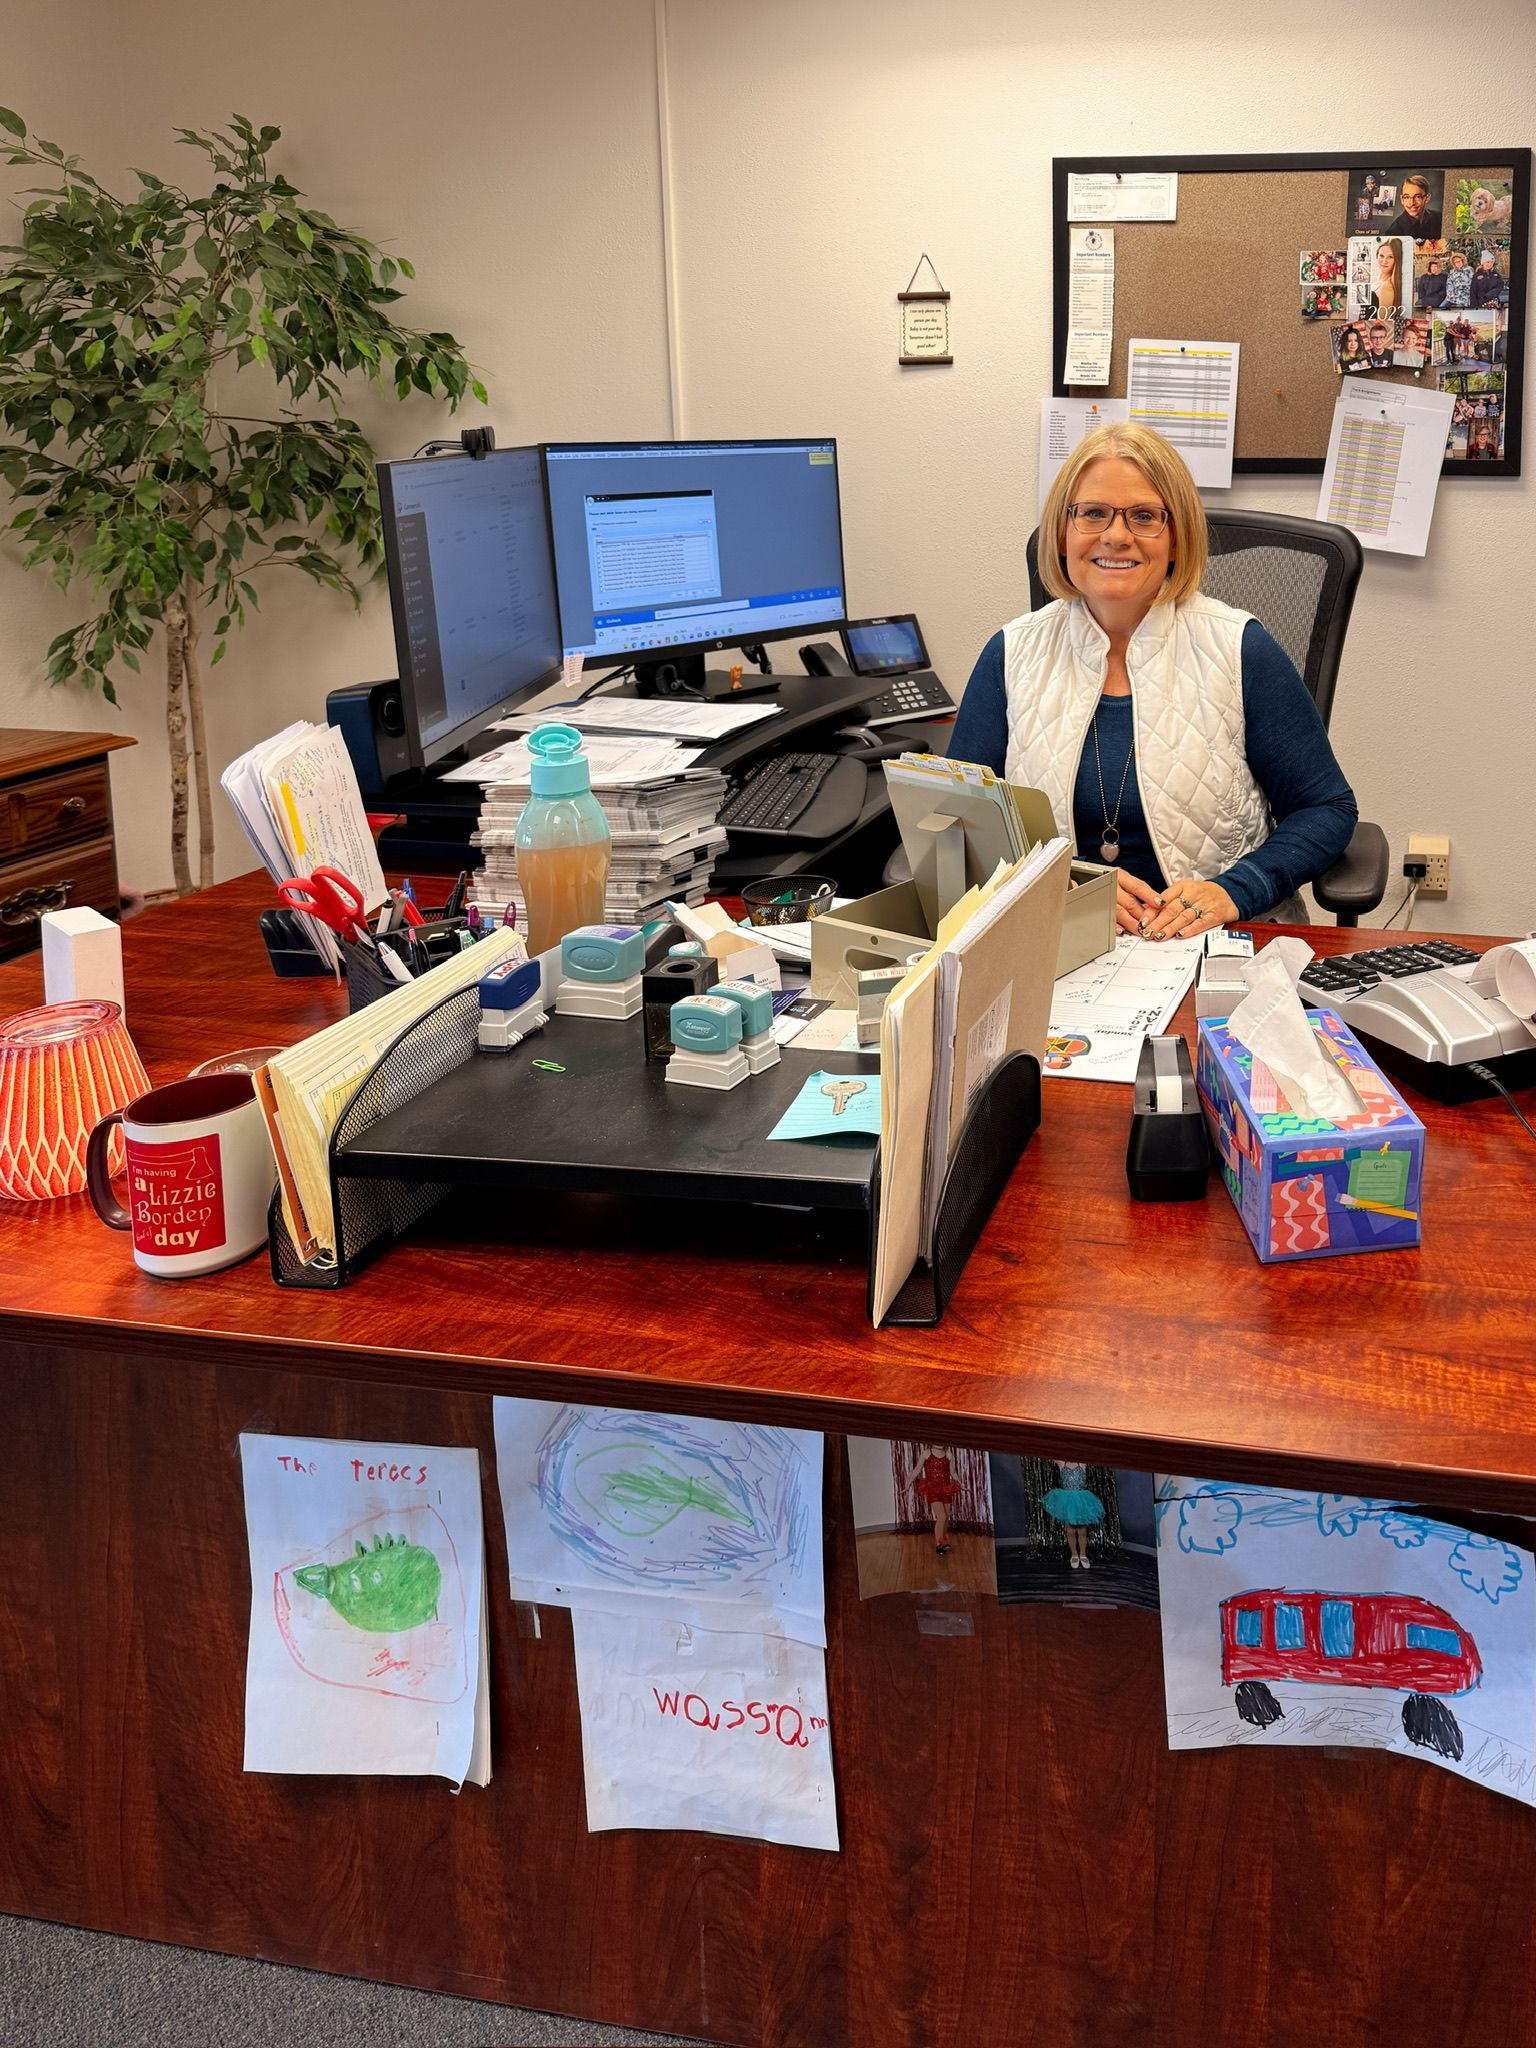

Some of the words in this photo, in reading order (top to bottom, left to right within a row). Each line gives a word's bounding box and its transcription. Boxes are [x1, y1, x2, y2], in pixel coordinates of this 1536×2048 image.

[1093, 1029, 1134, 1037] Sunday
[132, 1165, 143, 1175] I'm
[143, 1168, 177, 1178] having
[134, 1176, 147, 1192] a
[149, 1179, 217, 1206] Lizzie
[135, 1200, 212, 1227] Borden
[154, 1227, 201, 1248] day
